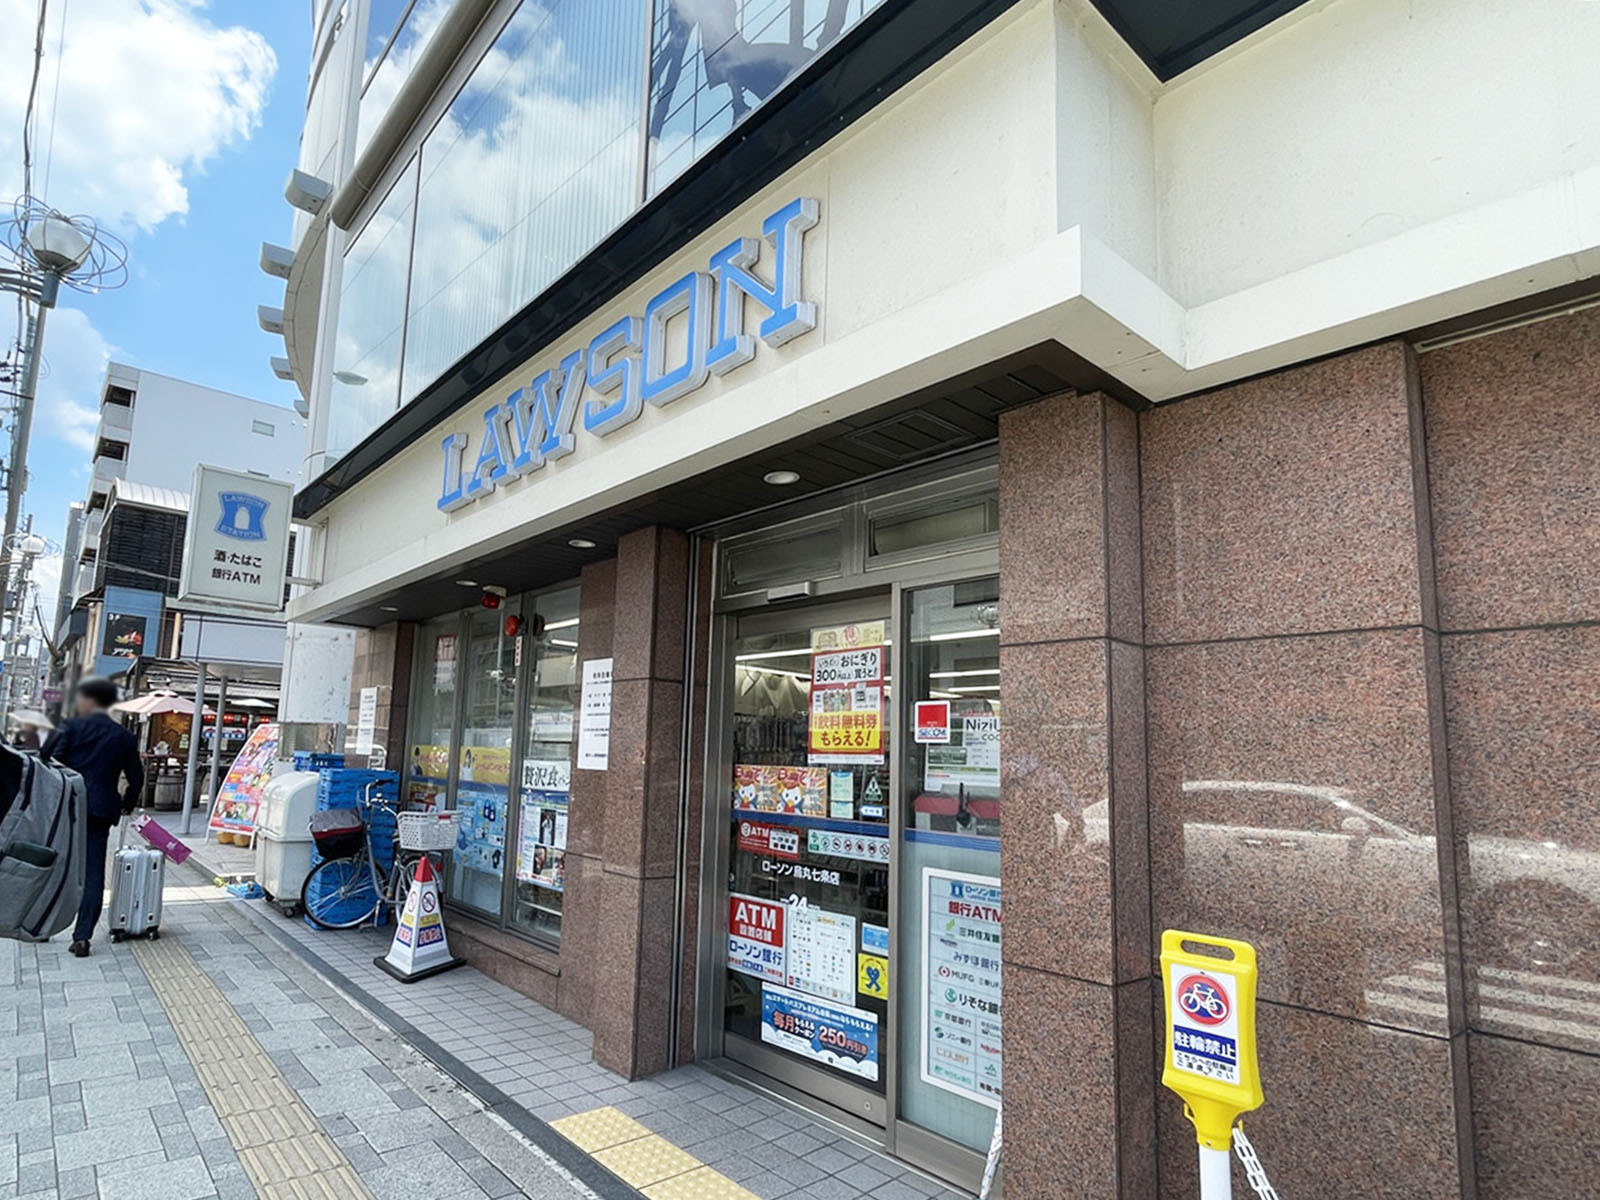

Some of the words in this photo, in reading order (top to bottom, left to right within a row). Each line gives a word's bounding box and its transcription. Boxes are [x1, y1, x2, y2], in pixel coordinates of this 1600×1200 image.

[437, 197, 819, 512] LAWSON
[211, 567, 262, 585] 銀行ATM
[840, 651, 877, 668] おにぎり
[821, 730, 872, 747] もらえる!
[750, 826, 770, 838] ATM
[734, 901, 777, 930] ATM
[728, 940, 783, 966] ローソン銀行
[1174, 1030, 1236, 1060] 駐輪禁止
